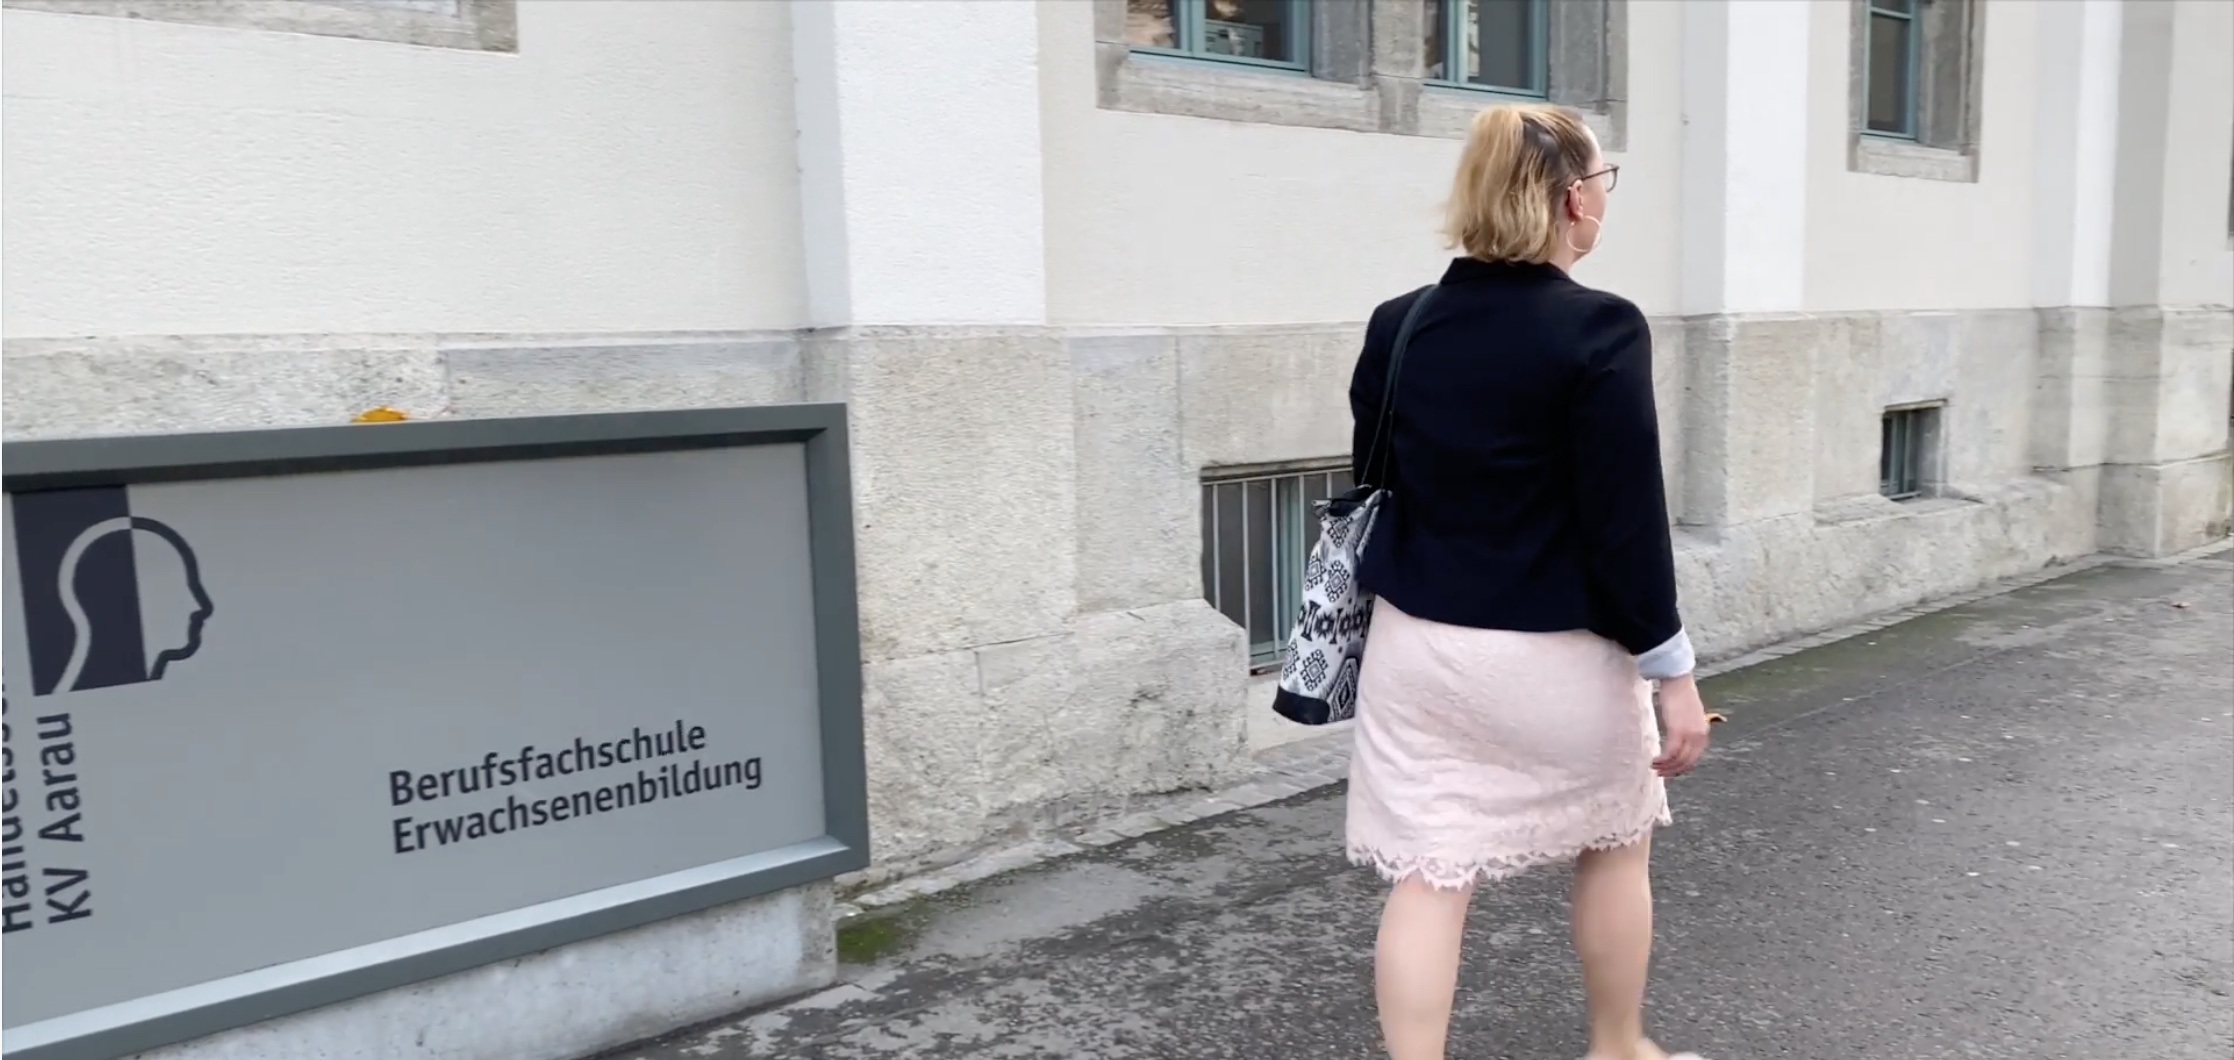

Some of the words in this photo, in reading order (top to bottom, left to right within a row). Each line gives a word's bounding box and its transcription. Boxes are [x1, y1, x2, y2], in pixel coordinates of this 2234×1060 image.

[37, 712, 84, 842] Aarau
[389, 720, 707, 806] Berufsfachschule
[392, 756, 763, 854] Erwachsenenbildung
[42, 867, 92, 924] KV
